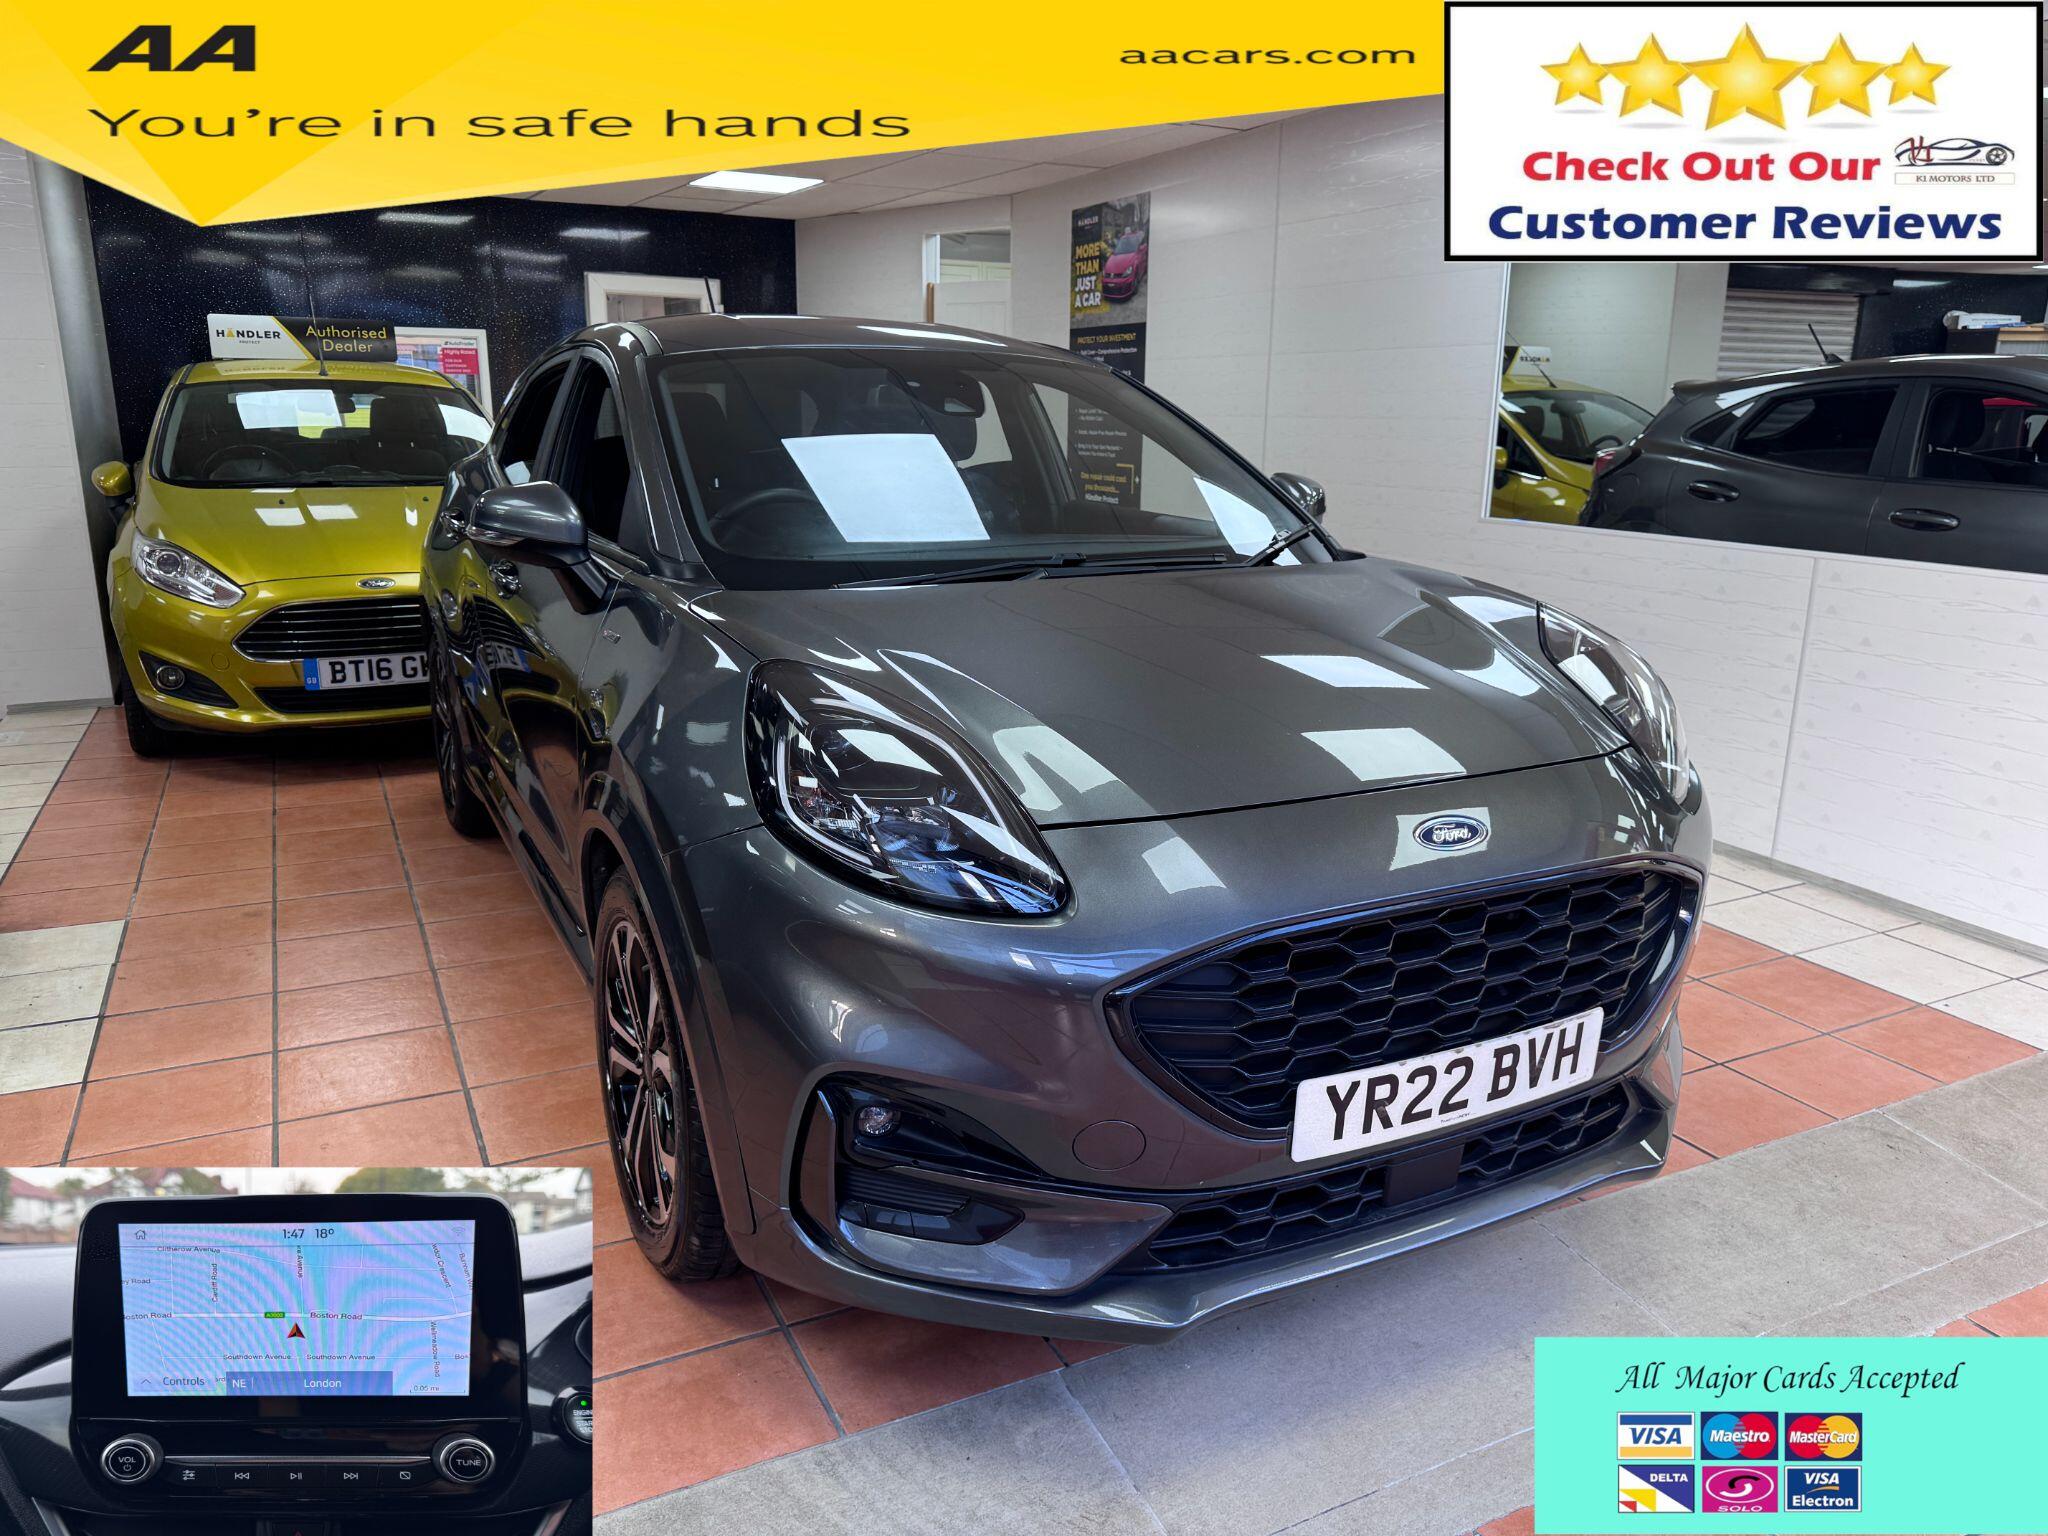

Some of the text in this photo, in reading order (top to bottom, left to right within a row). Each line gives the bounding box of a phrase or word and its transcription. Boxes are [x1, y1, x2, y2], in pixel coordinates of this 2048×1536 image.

[1075, 242, 1101, 260] MORE
[1075, 259, 1100, 275] THAN
[1075, 276, 1096, 292] JUST
[1074, 291, 1102, 308] A CAR
[306, 325, 387, 340] Authorised
[322, 339, 373, 353] Dealer
[328, 657, 393, 684] BT16
[1432, 823, 1472, 844] Ford
[1325, 1021, 1585, 1141] YR22 BVH
[283, 1228, 305, 1239] 1:47
[310, 1312, 363, 1320] Boston Road
[162, 1376, 205, 1387] Controls
[232, 1379, 247, 1388] NE
[303, 1378, 342, 1388] London
[455, 1458, 481, 1467] TUNE
